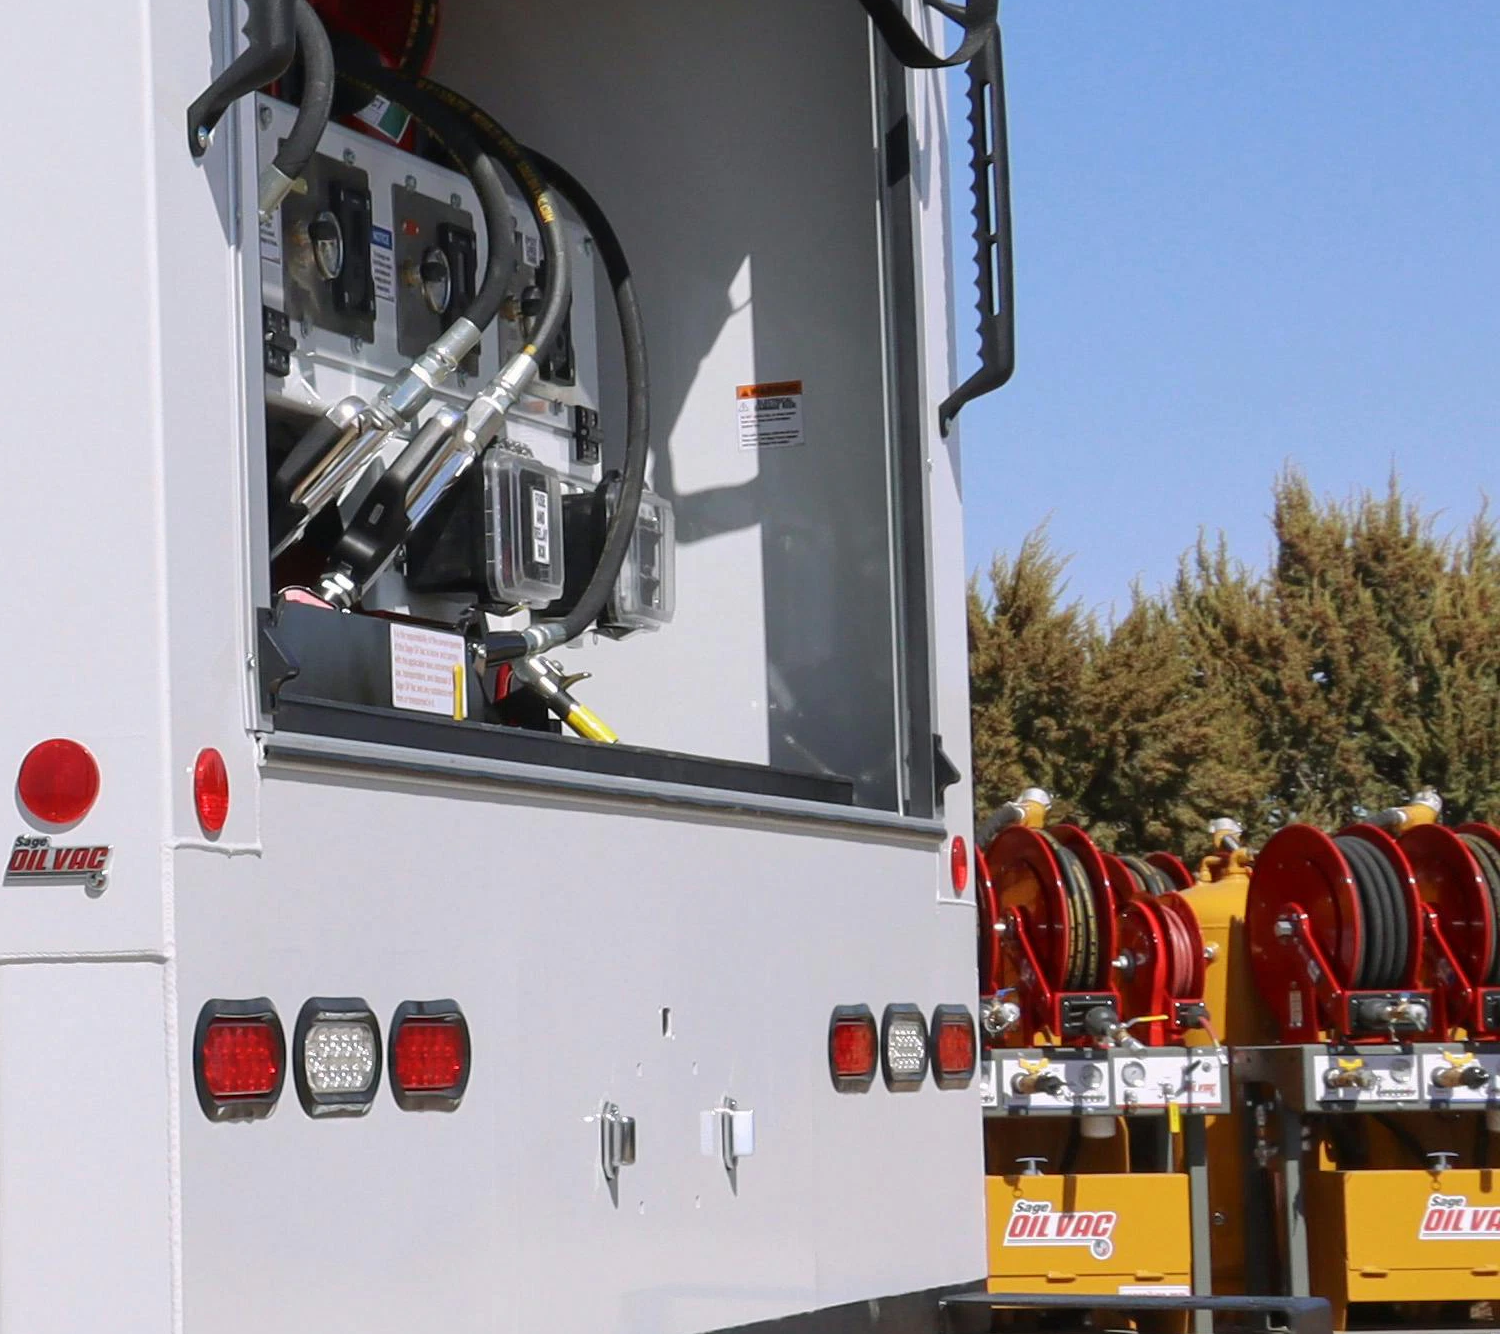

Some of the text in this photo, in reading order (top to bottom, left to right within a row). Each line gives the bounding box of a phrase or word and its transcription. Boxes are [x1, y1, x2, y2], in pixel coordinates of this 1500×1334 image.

[14, 836, 48, 848] Sage
[9, 846, 110, 871] OIL VAC
[1015, 1202, 1049, 1214] Sage
[1431, 1196, 1463, 1208] Sage
[1008, 1214, 1114, 1238] OIL VAC
[1424, 1209, 1500, 1231] OIL VA
